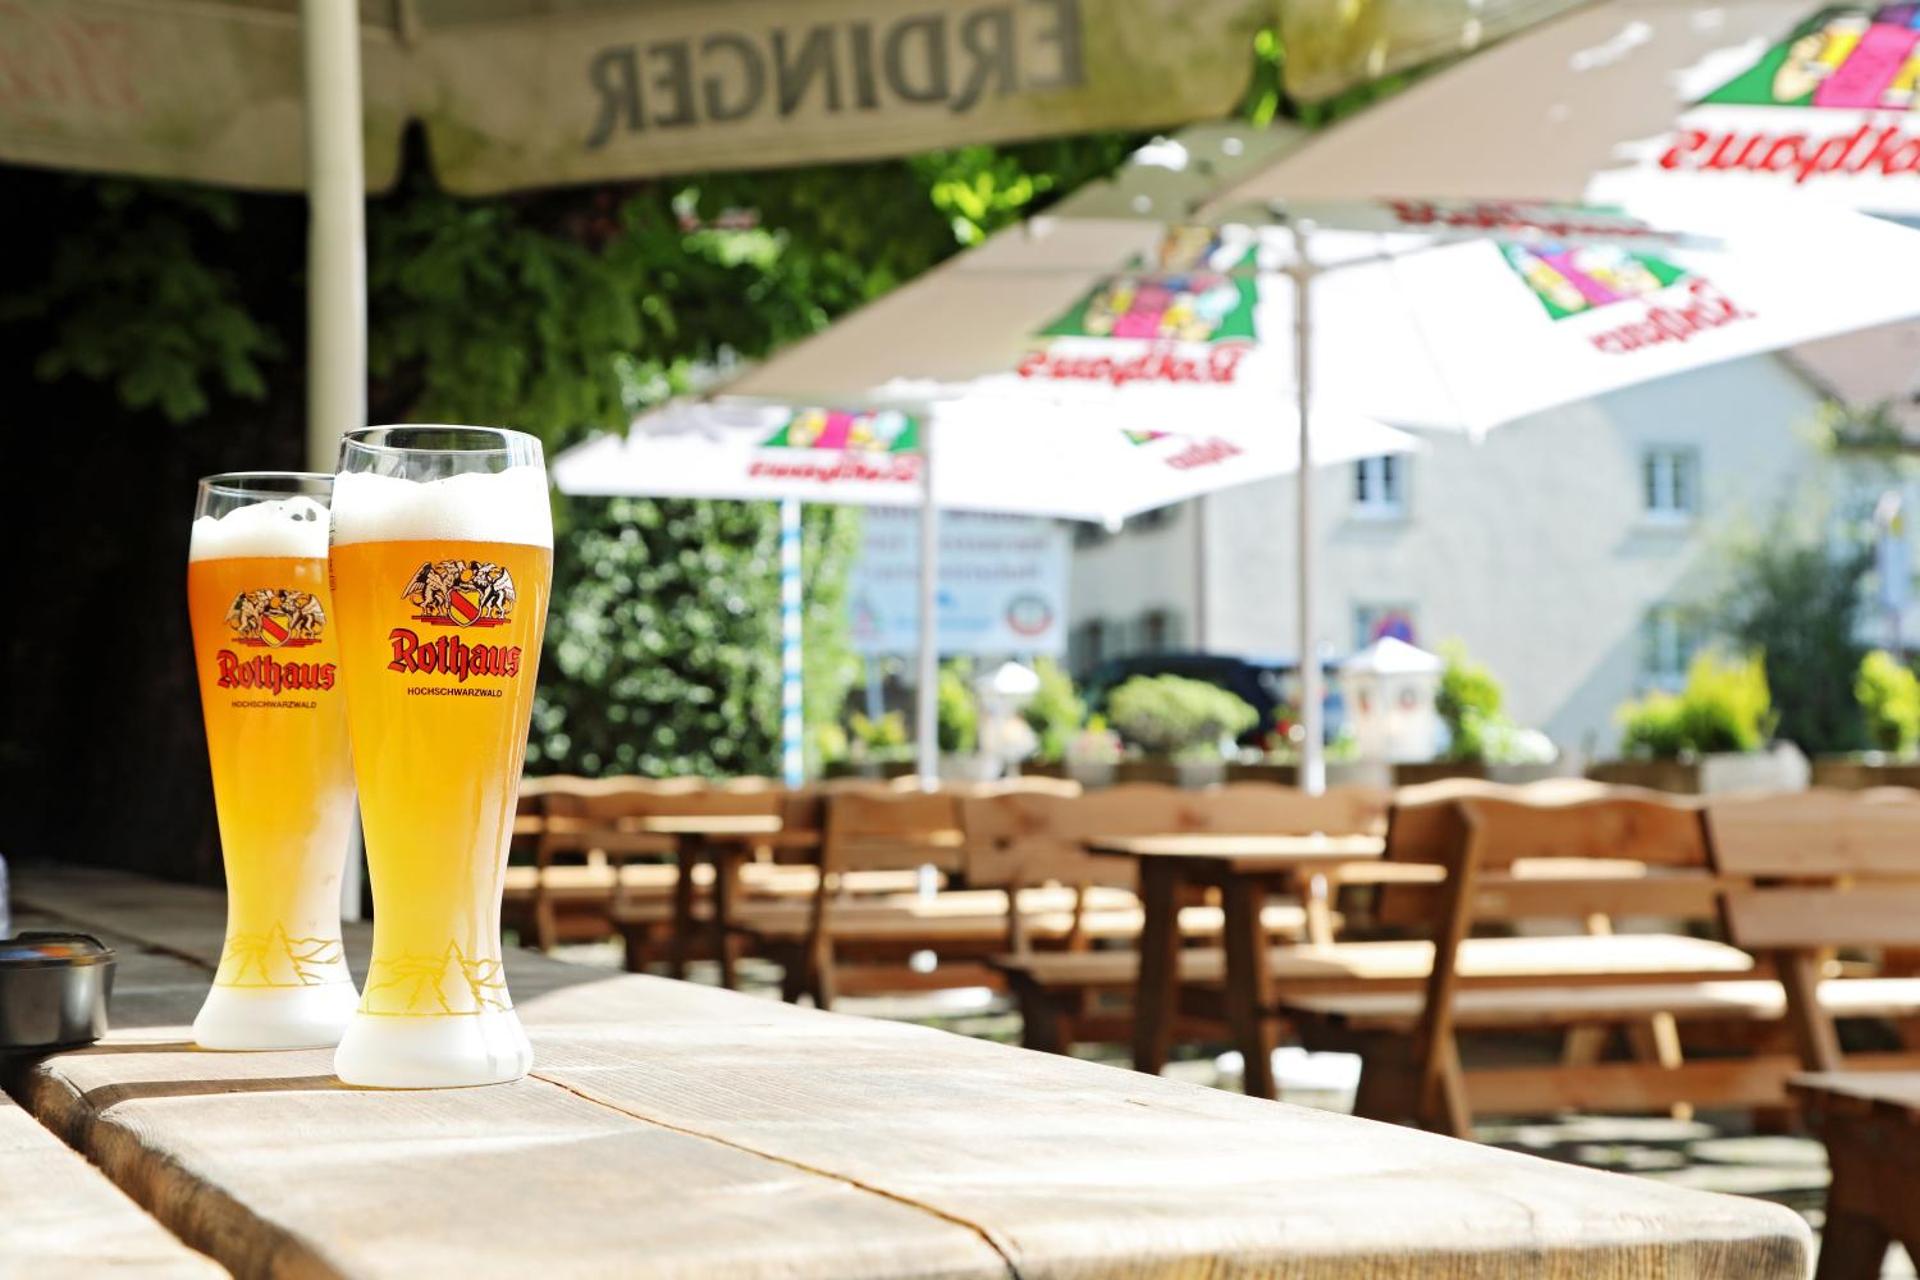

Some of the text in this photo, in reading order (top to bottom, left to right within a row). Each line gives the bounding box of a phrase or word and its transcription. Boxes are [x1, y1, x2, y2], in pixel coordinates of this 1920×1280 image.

[387, 628, 521, 683] Rothaus
[216, 650, 336, 696] Rothaus
[231, 700, 317, 709] HOCHSCHWARZWALD
[407, 687, 502, 698] HOCHSCHWARZWALD
